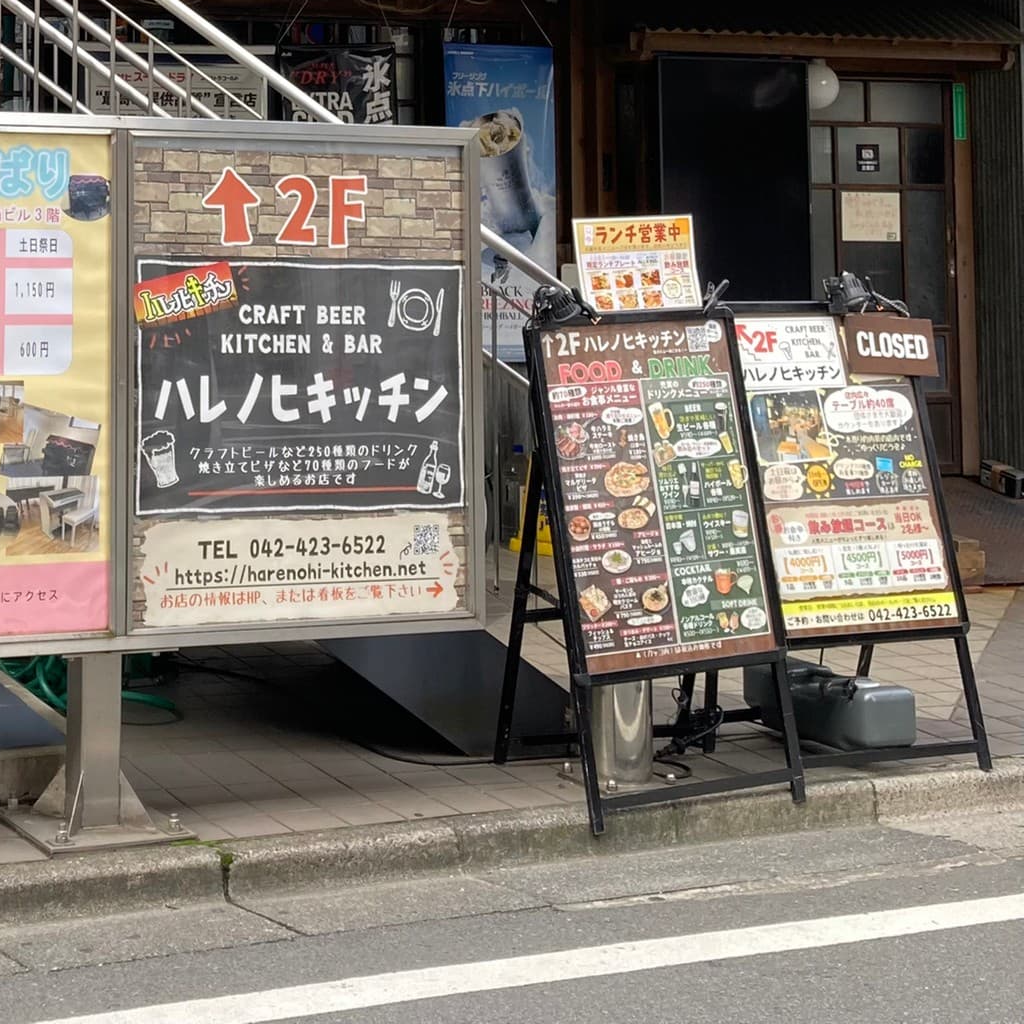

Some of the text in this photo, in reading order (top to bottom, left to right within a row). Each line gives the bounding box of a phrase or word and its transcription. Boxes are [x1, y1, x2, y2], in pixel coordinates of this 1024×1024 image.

[363, 61, 393, 125] 氷点
[275, 174, 368, 249] 2F
[596, 223, 680, 244] ランチ営業中
[19, 238, 58, 253] 土日祭日
[15, 282, 55, 299] 1,150円
[239, 306, 366, 325] CRAFT BEER
[810, 325, 826, 333] BEER
[20, 341, 49, 358] 600円
[220, 334, 382, 354] KITCHEN & BAR
[555, 332, 580, 356] 2F
[584, 330, 685, 353] ハレノヒキッチン
[752, 331, 777, 353] 2F
[791, 338, 821, 346] KITCHEN
[856, 331, 928, 360] CLOSED
[805, 351, 820, 359] BAR
[559, 355, 713, 384] FOOD & DRINK
[744, 366, 840, 382] ハレノヒキッチン
[154, 372, 449, 424] ハレノヒキッチン
[647, 389, 708, 400] ドリンクメニュー
[254, 473, 356, 487] 楽しめるお店です
[198, 535, 386, 560] TEL 042-423-6522
[175, 561, 426, 586] https://harenohi-kitchen.net
[868, 604, 952, 622] 042-423-6522
